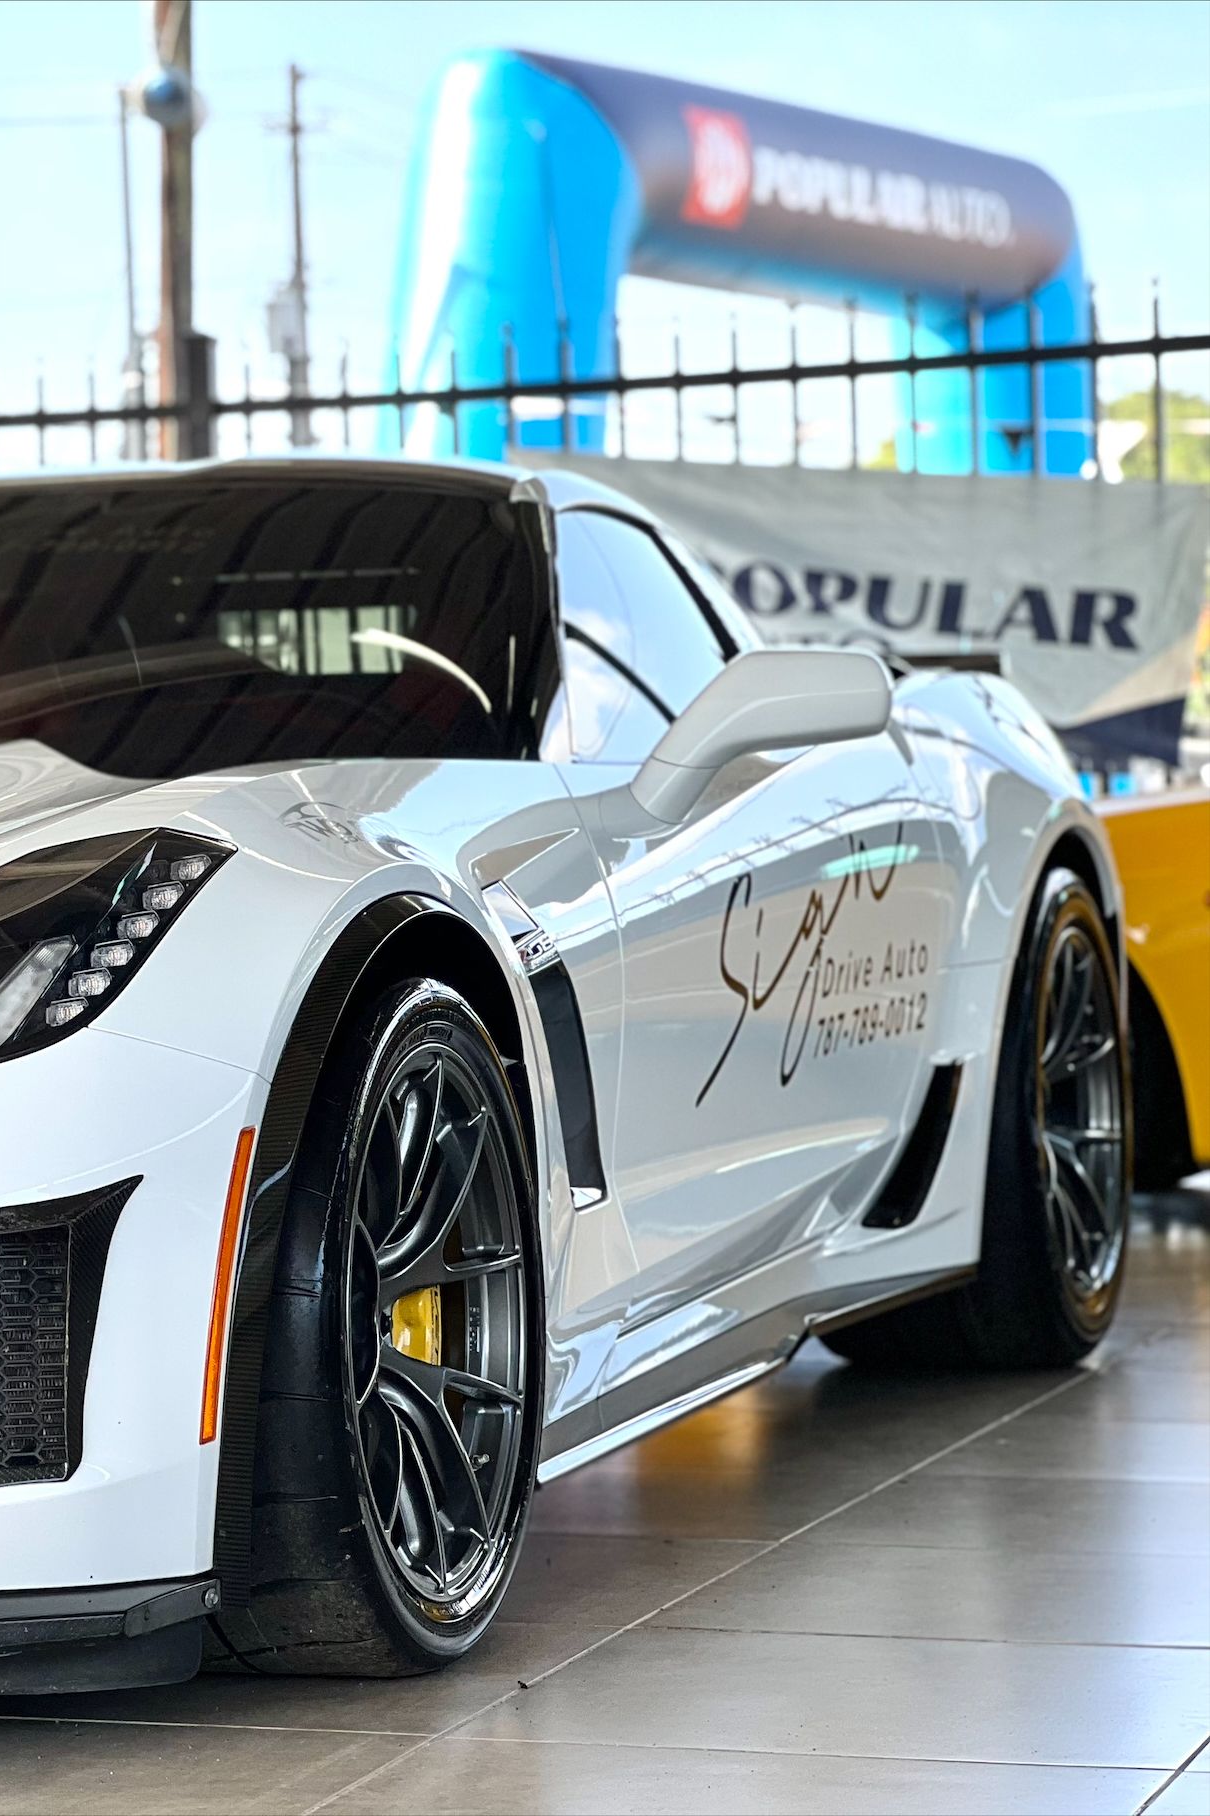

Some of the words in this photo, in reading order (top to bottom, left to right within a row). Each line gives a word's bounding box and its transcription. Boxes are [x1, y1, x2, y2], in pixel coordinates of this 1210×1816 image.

[707, 560, 1138, 651] OPULAR
[822, 951, 873, 998] Drive
[880, 941, 928, 984] Auto
[813, 991, 928, 1059] 787-789-0012
